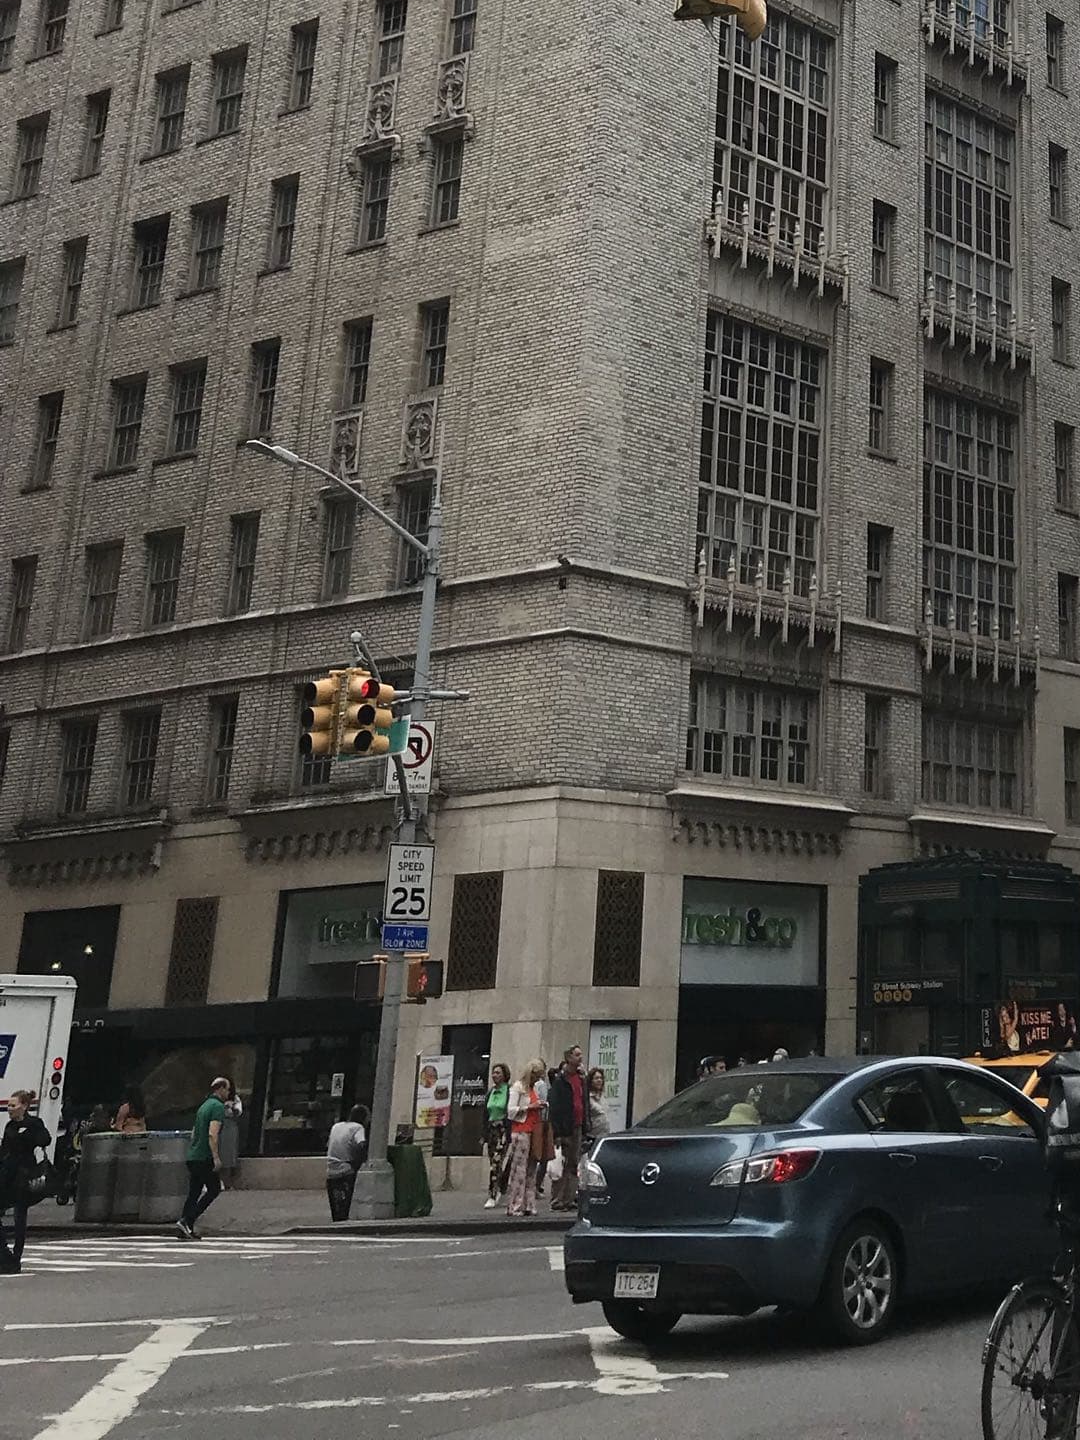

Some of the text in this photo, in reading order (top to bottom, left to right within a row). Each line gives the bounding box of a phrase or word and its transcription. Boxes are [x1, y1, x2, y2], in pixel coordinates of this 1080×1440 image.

[403, 850, 422, 859] CITY
[397, 862, 425, 872] SPEED
[400, 874, 422, 883] LIMIT
[390, 886, 426, 916] 25
[384, 939, 425, 948] SLOW ZONE
[922, 980, 944, 989] Station
[1021, 1011, 1055, 1026] KISS ME,
[600, 1035, 619, 1049] SAVE
[1025, 1026, 1051, 1046] KATE!
[599, 1051, 618, 1066] TIME,
